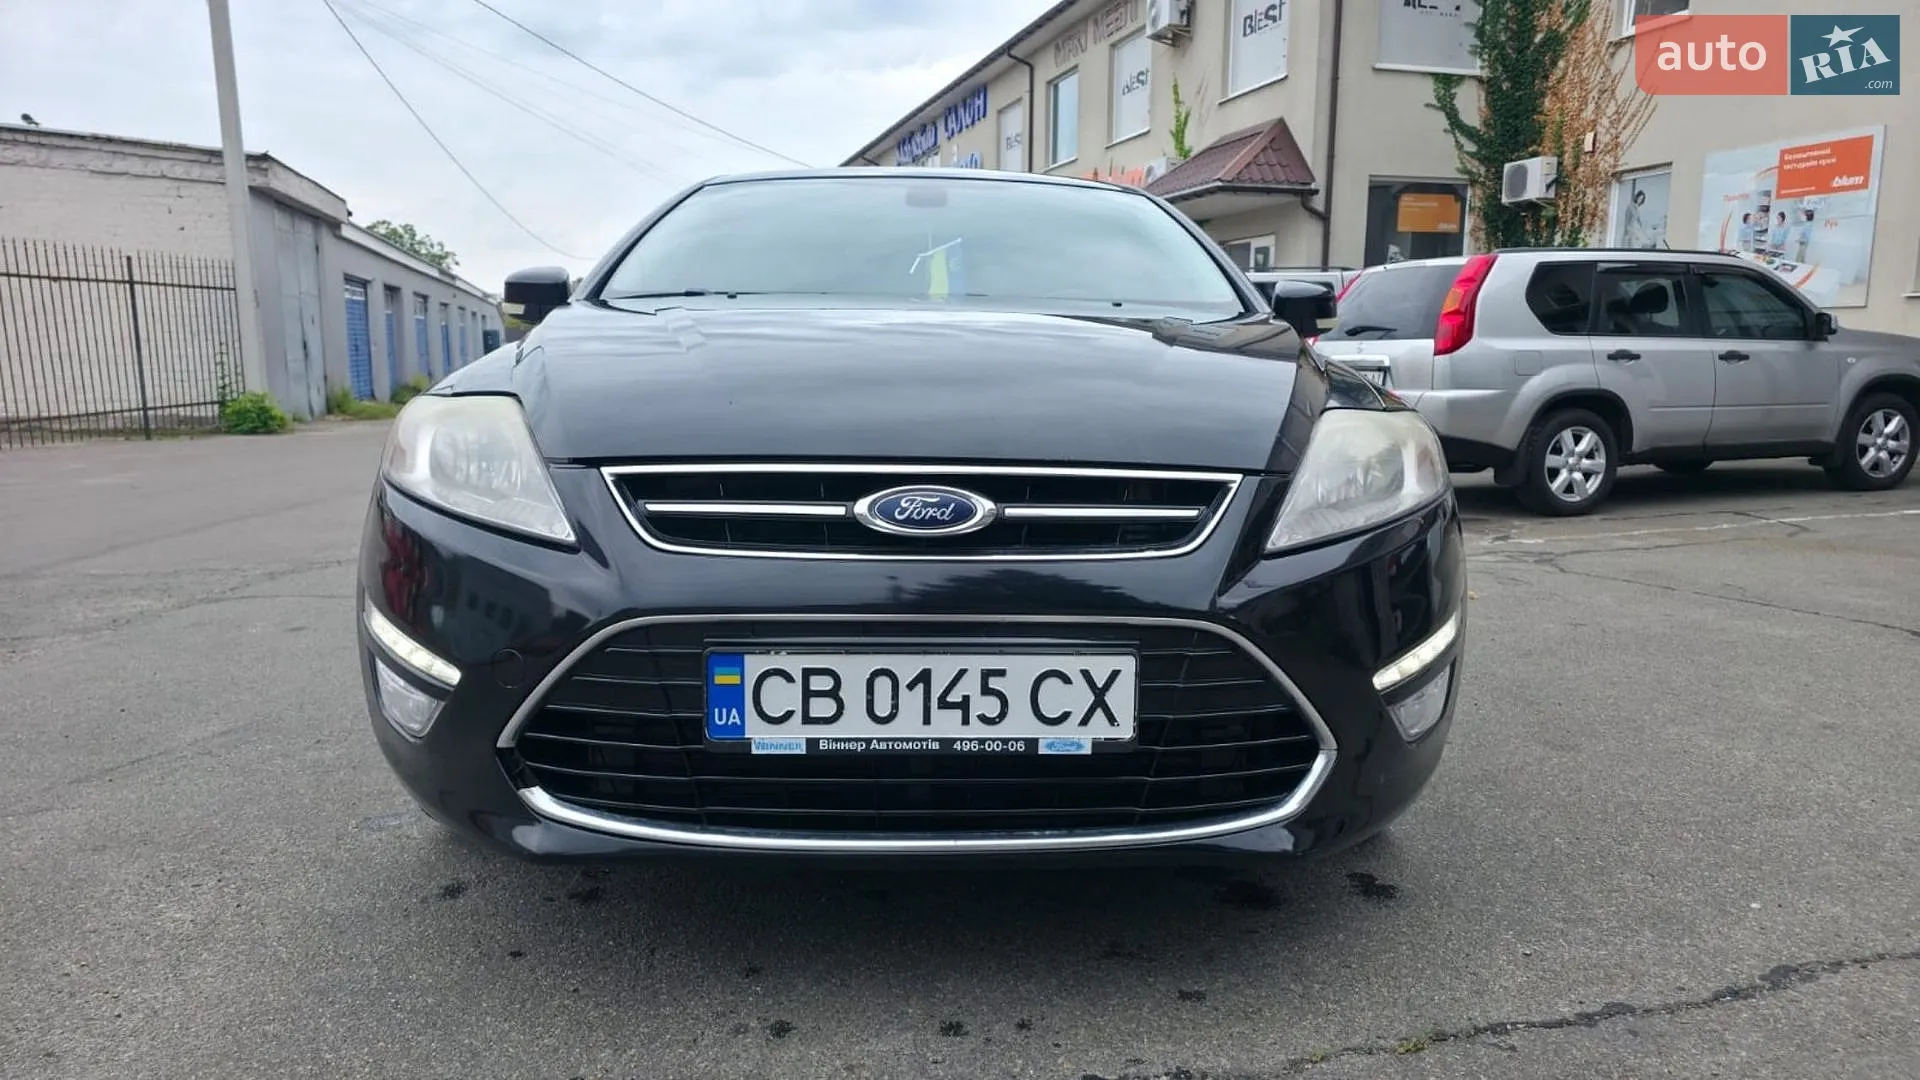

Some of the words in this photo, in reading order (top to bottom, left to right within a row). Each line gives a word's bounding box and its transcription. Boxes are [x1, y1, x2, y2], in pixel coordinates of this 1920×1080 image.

[894, 496, 955, 520] Ford
[752, 667, 845, 726] CB
[865, 667, 1009, 726] 0145
[1029, 668, 1122, 727] CX
[714, 708, 741, 726] UA
[819, 739, 866, 752] Віннер
[870, 738, 940, 751] Автомотів
[952, 740, 1025, 751] 496-00-06
